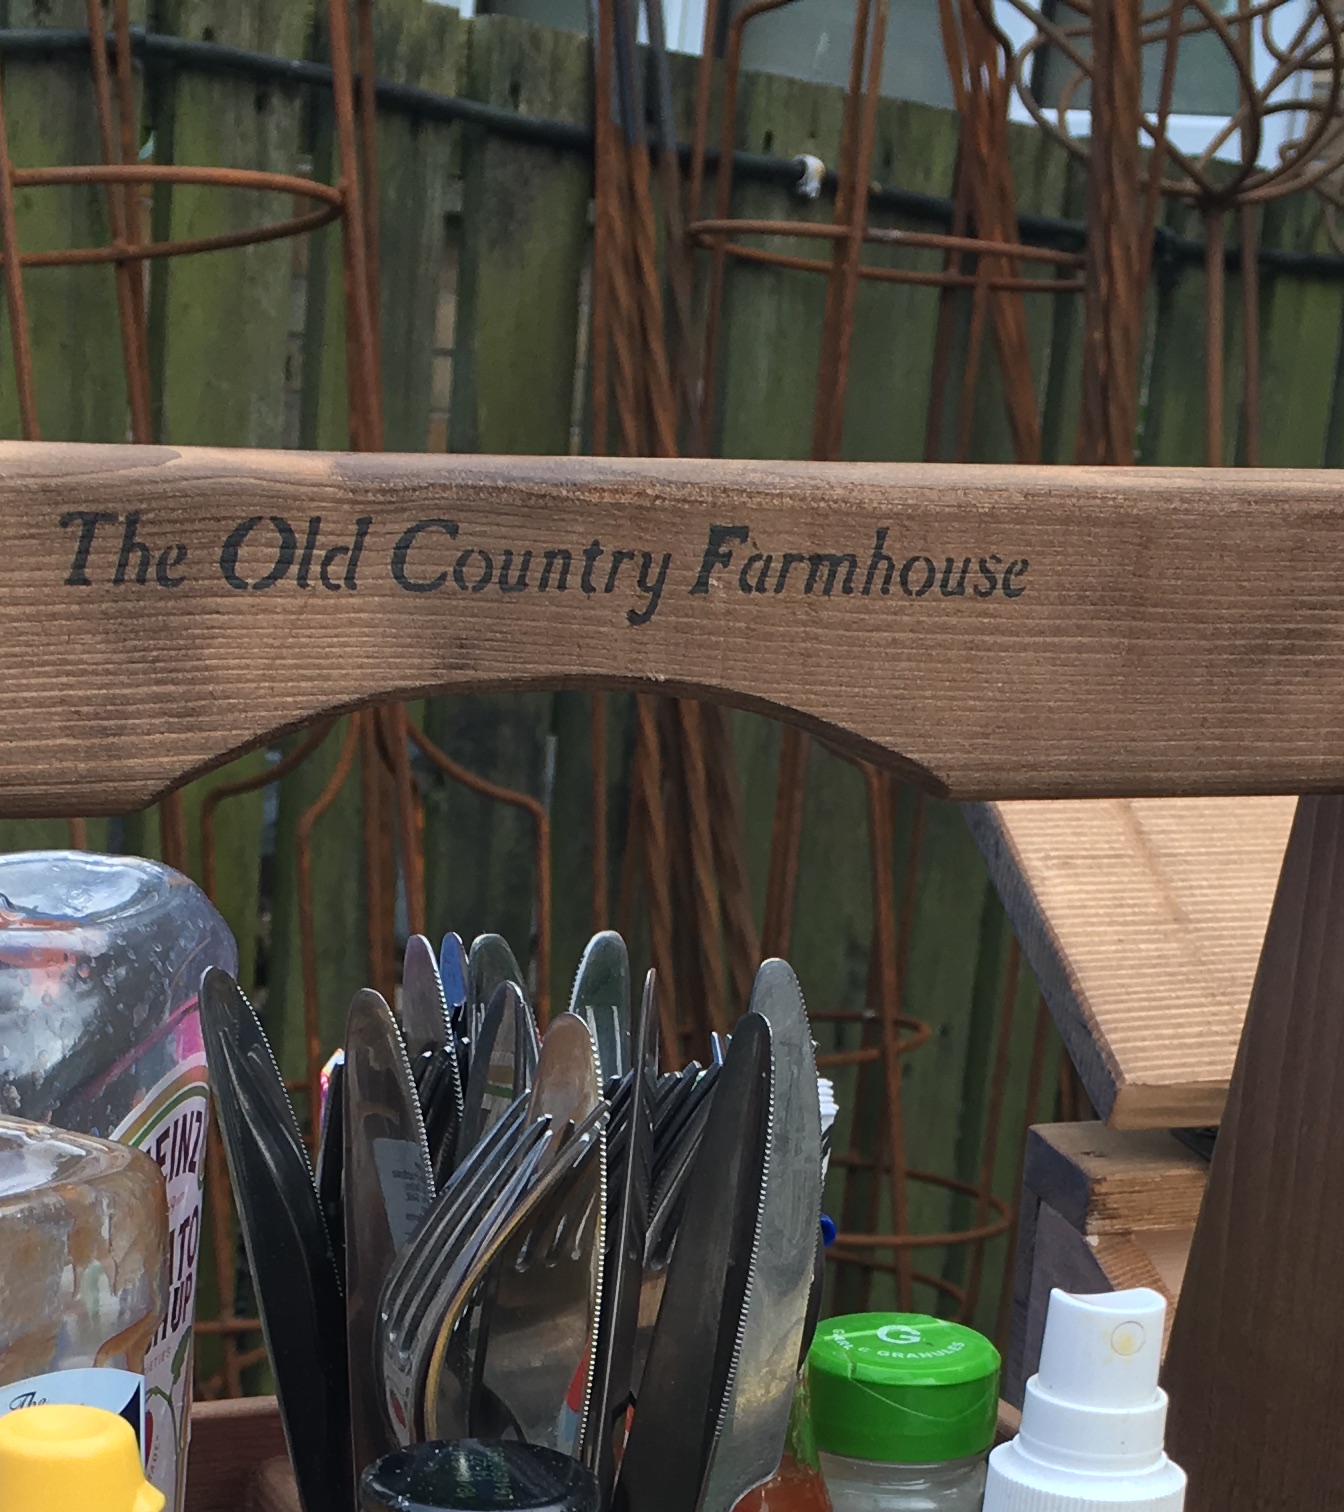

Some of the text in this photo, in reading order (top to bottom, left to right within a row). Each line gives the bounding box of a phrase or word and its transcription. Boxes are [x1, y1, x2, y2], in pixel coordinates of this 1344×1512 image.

[58, 510, 1029, 626] The Old Country Farmhouse
[146, 1110, 203, 1183] EINZ
